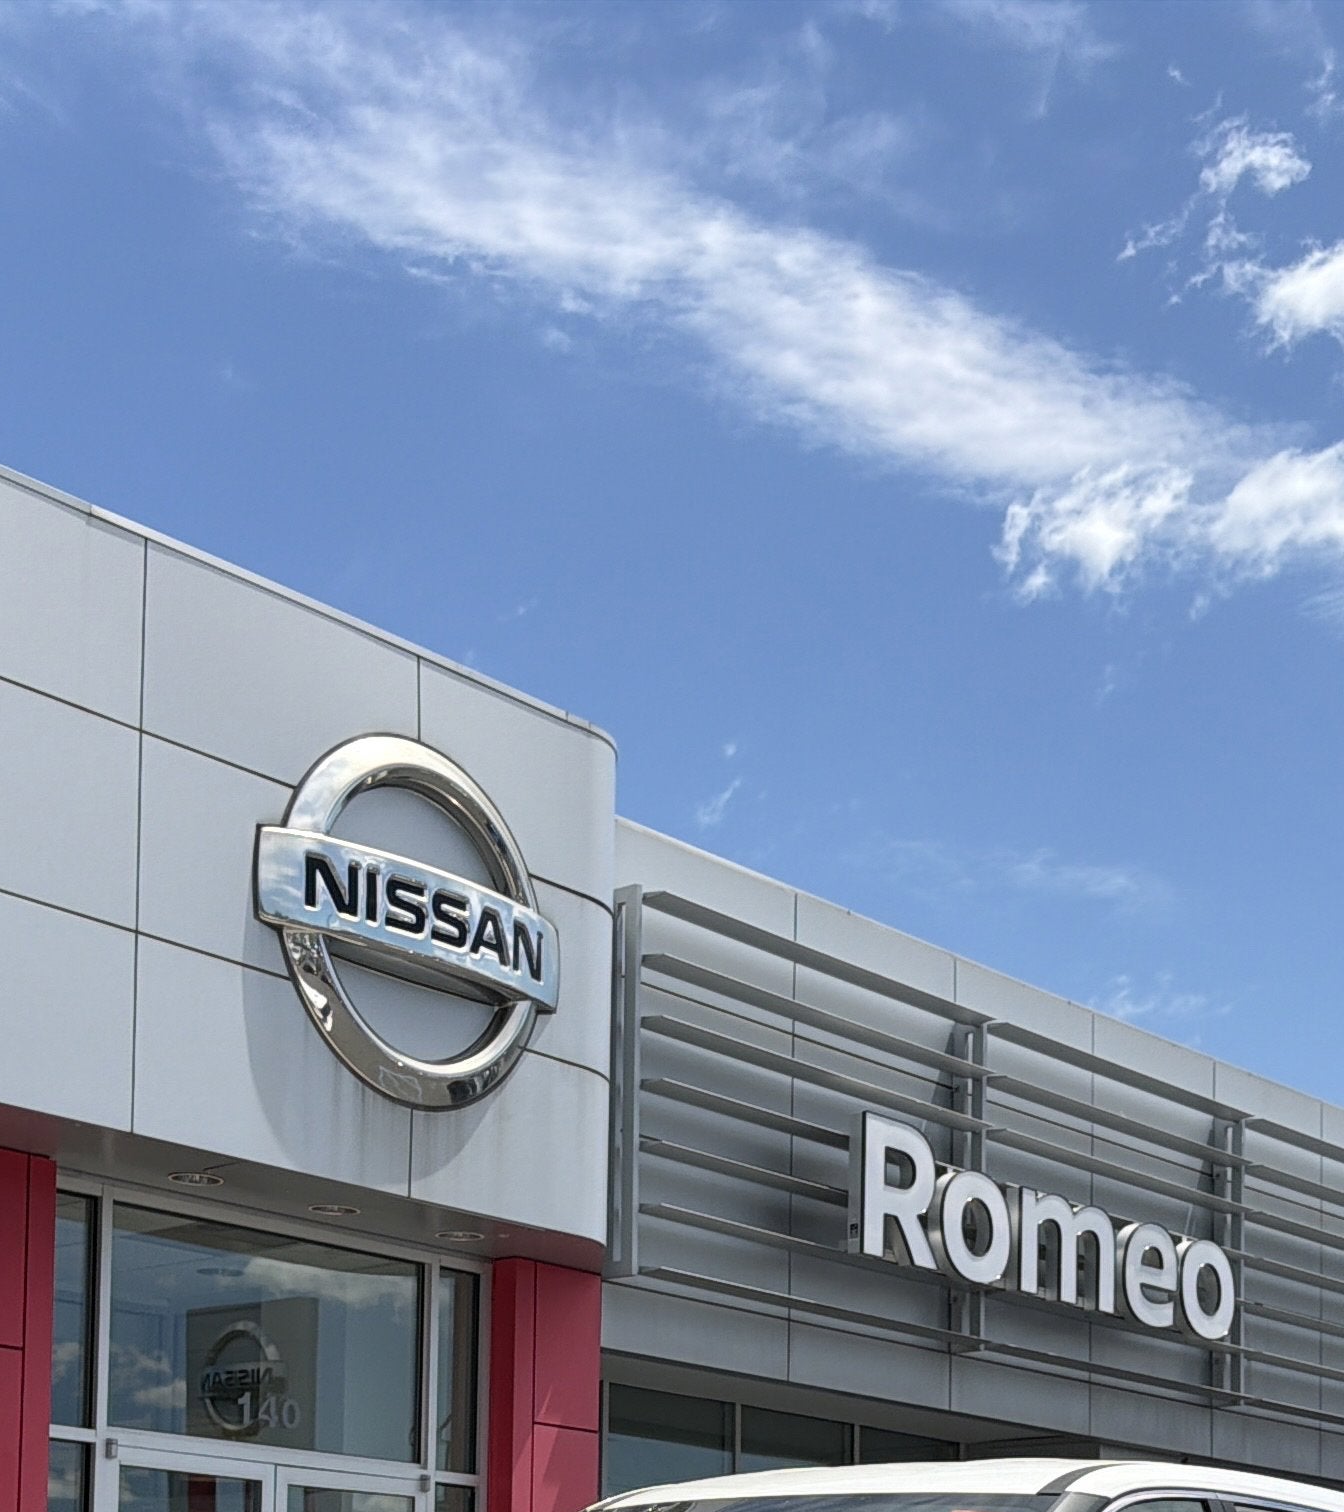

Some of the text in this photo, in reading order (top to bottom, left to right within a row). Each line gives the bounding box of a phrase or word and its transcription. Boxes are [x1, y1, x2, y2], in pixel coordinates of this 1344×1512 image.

[303, 851, 545, 984] NISSAN
[859, 1110, 1236, 1341] Romeo
[238, 1391, 301, 1429] 140
